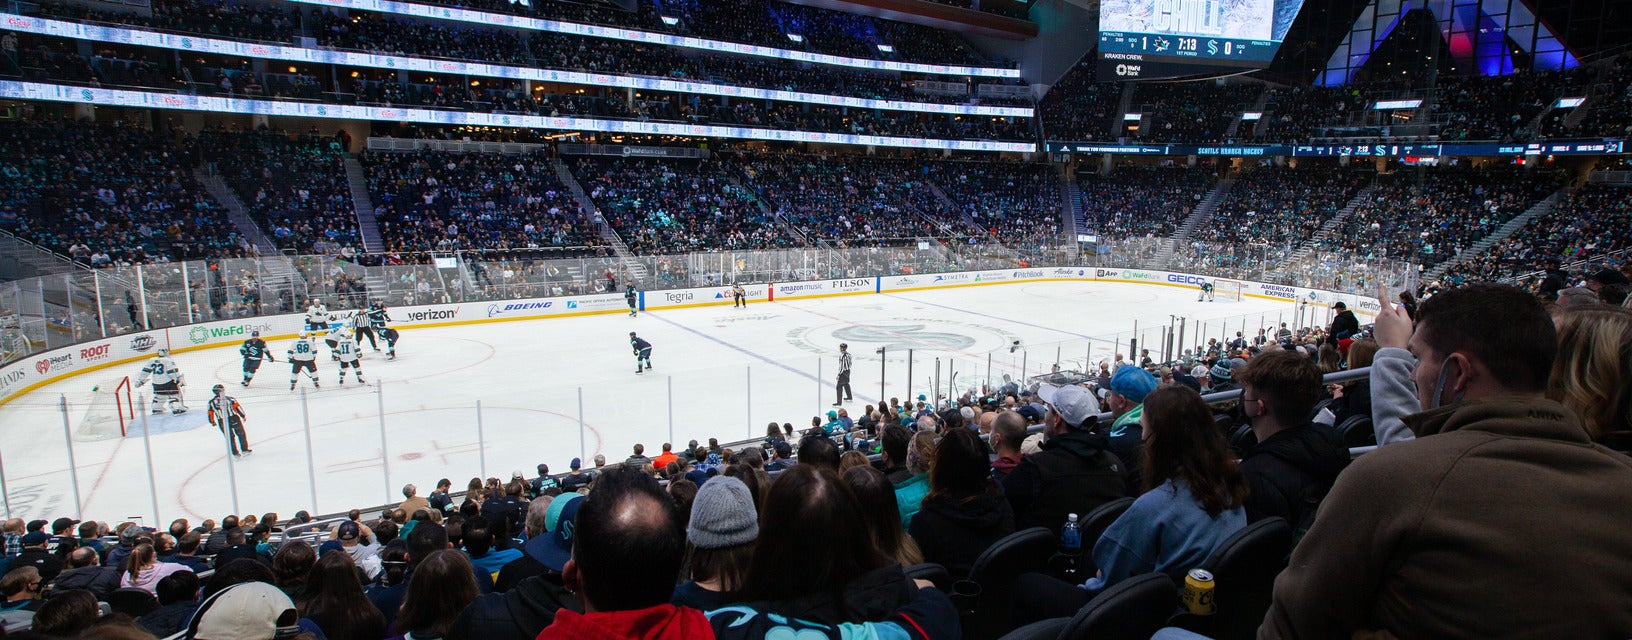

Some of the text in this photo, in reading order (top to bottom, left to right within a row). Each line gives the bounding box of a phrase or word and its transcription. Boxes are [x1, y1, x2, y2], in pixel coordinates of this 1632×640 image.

[1153, 0, 1222, 35] CHILL
[1142, 36, 1147, 50] 1
[1178, 38, 1197, 50] 7:13
[1224, 41, 1231, 55] 0
[1018, 270, 1044, 278] PitchBook
[1167, 274, 1205, 285] GEICO
[832, 279, 871, 288] FILSON
[1260, 284, 1296, 293] AMERICAN
[665, 291, 694, 304] Tegria
[1264, 290, 1295, 299] EXPRESS
[504, 301, 553, 311] BOEING
[408, 309, 455, 321] verizon
[210, 322, 273, 337] WaFd Bank
[130, 336, 157, 350] NHL
[296, 343, 310, 354] 88
[80, 343, 111, 359] ROOT
[341, 344, 350, 354] 11
[50, 353, 72, 364] iHeart
[86, 354, 108, 362] SPORTS
[51, 361, 73, 371] MEDIA
